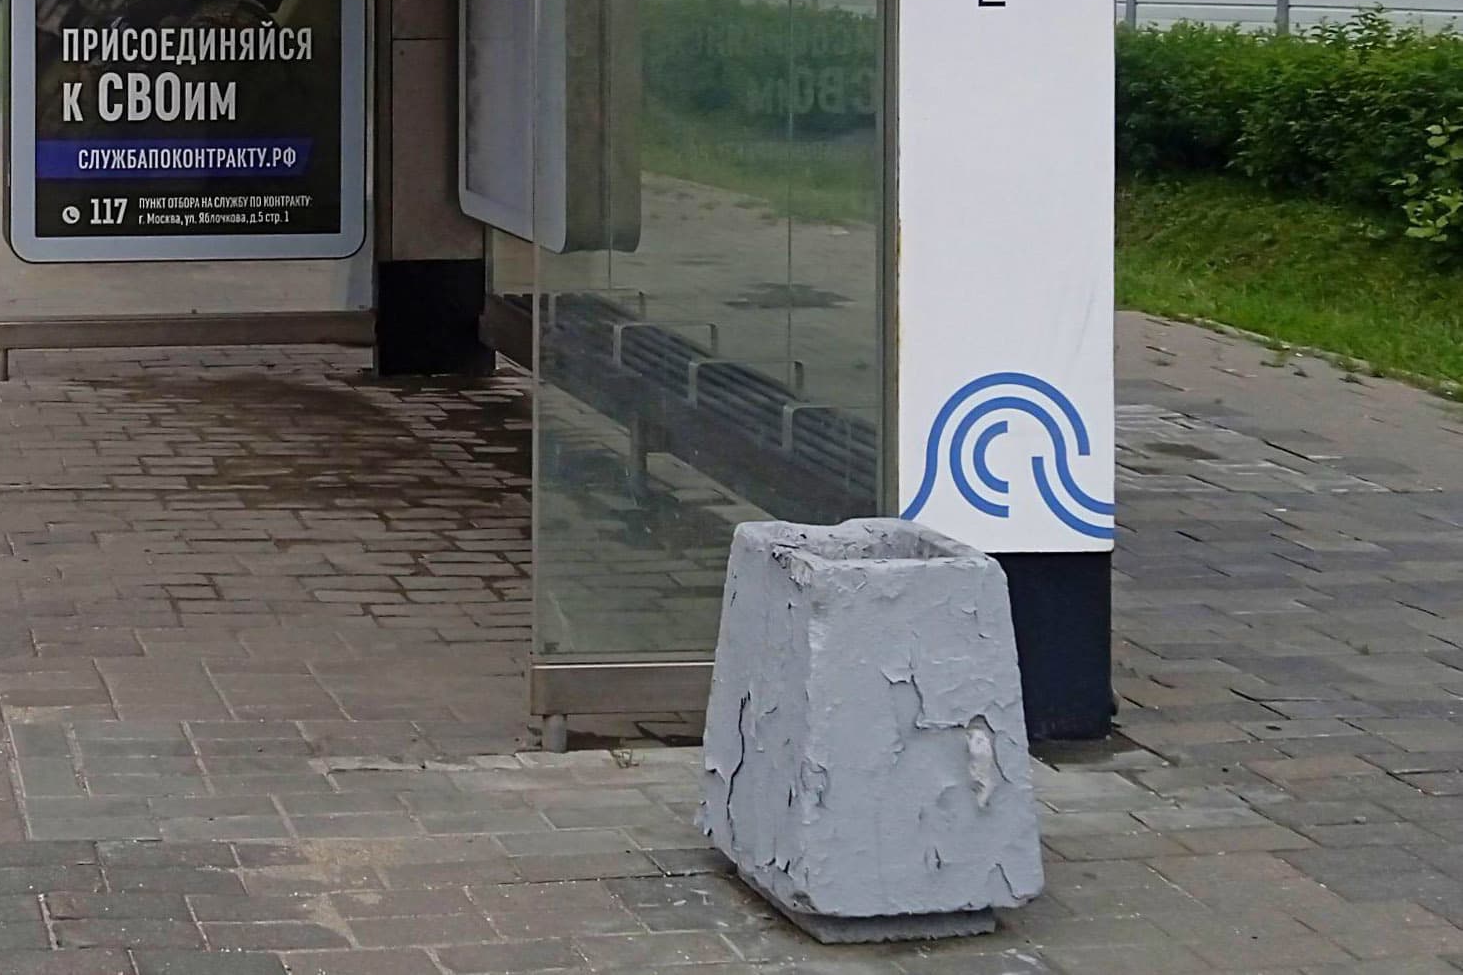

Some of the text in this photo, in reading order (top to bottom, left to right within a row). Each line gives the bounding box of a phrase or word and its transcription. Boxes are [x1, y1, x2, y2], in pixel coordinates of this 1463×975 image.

[62, 21, 312, 65] ПРИСОЕДИНЯЙСЯ
[98, 71, 237, 123] СВОим
[78, 147, 297, 170] СЛУЖБАПОКОНТРАКТУ.РФ
[90, 197, 128, 225] 117
[139, 197, 166, 210] ПУНКТ
[167, 197, 200, 209] ОТБОРА
[201, 196, 213, 208] НА
[214, 196, 248, 208] СЛУЖБУ
[250, 196, 262, 208] ПО
[147, 213, 184, 226] Москва,
[184, 215, 197, 227] ул.
[265, 213, 283, 225] стр.
[284, 210, 290, 222] 1
